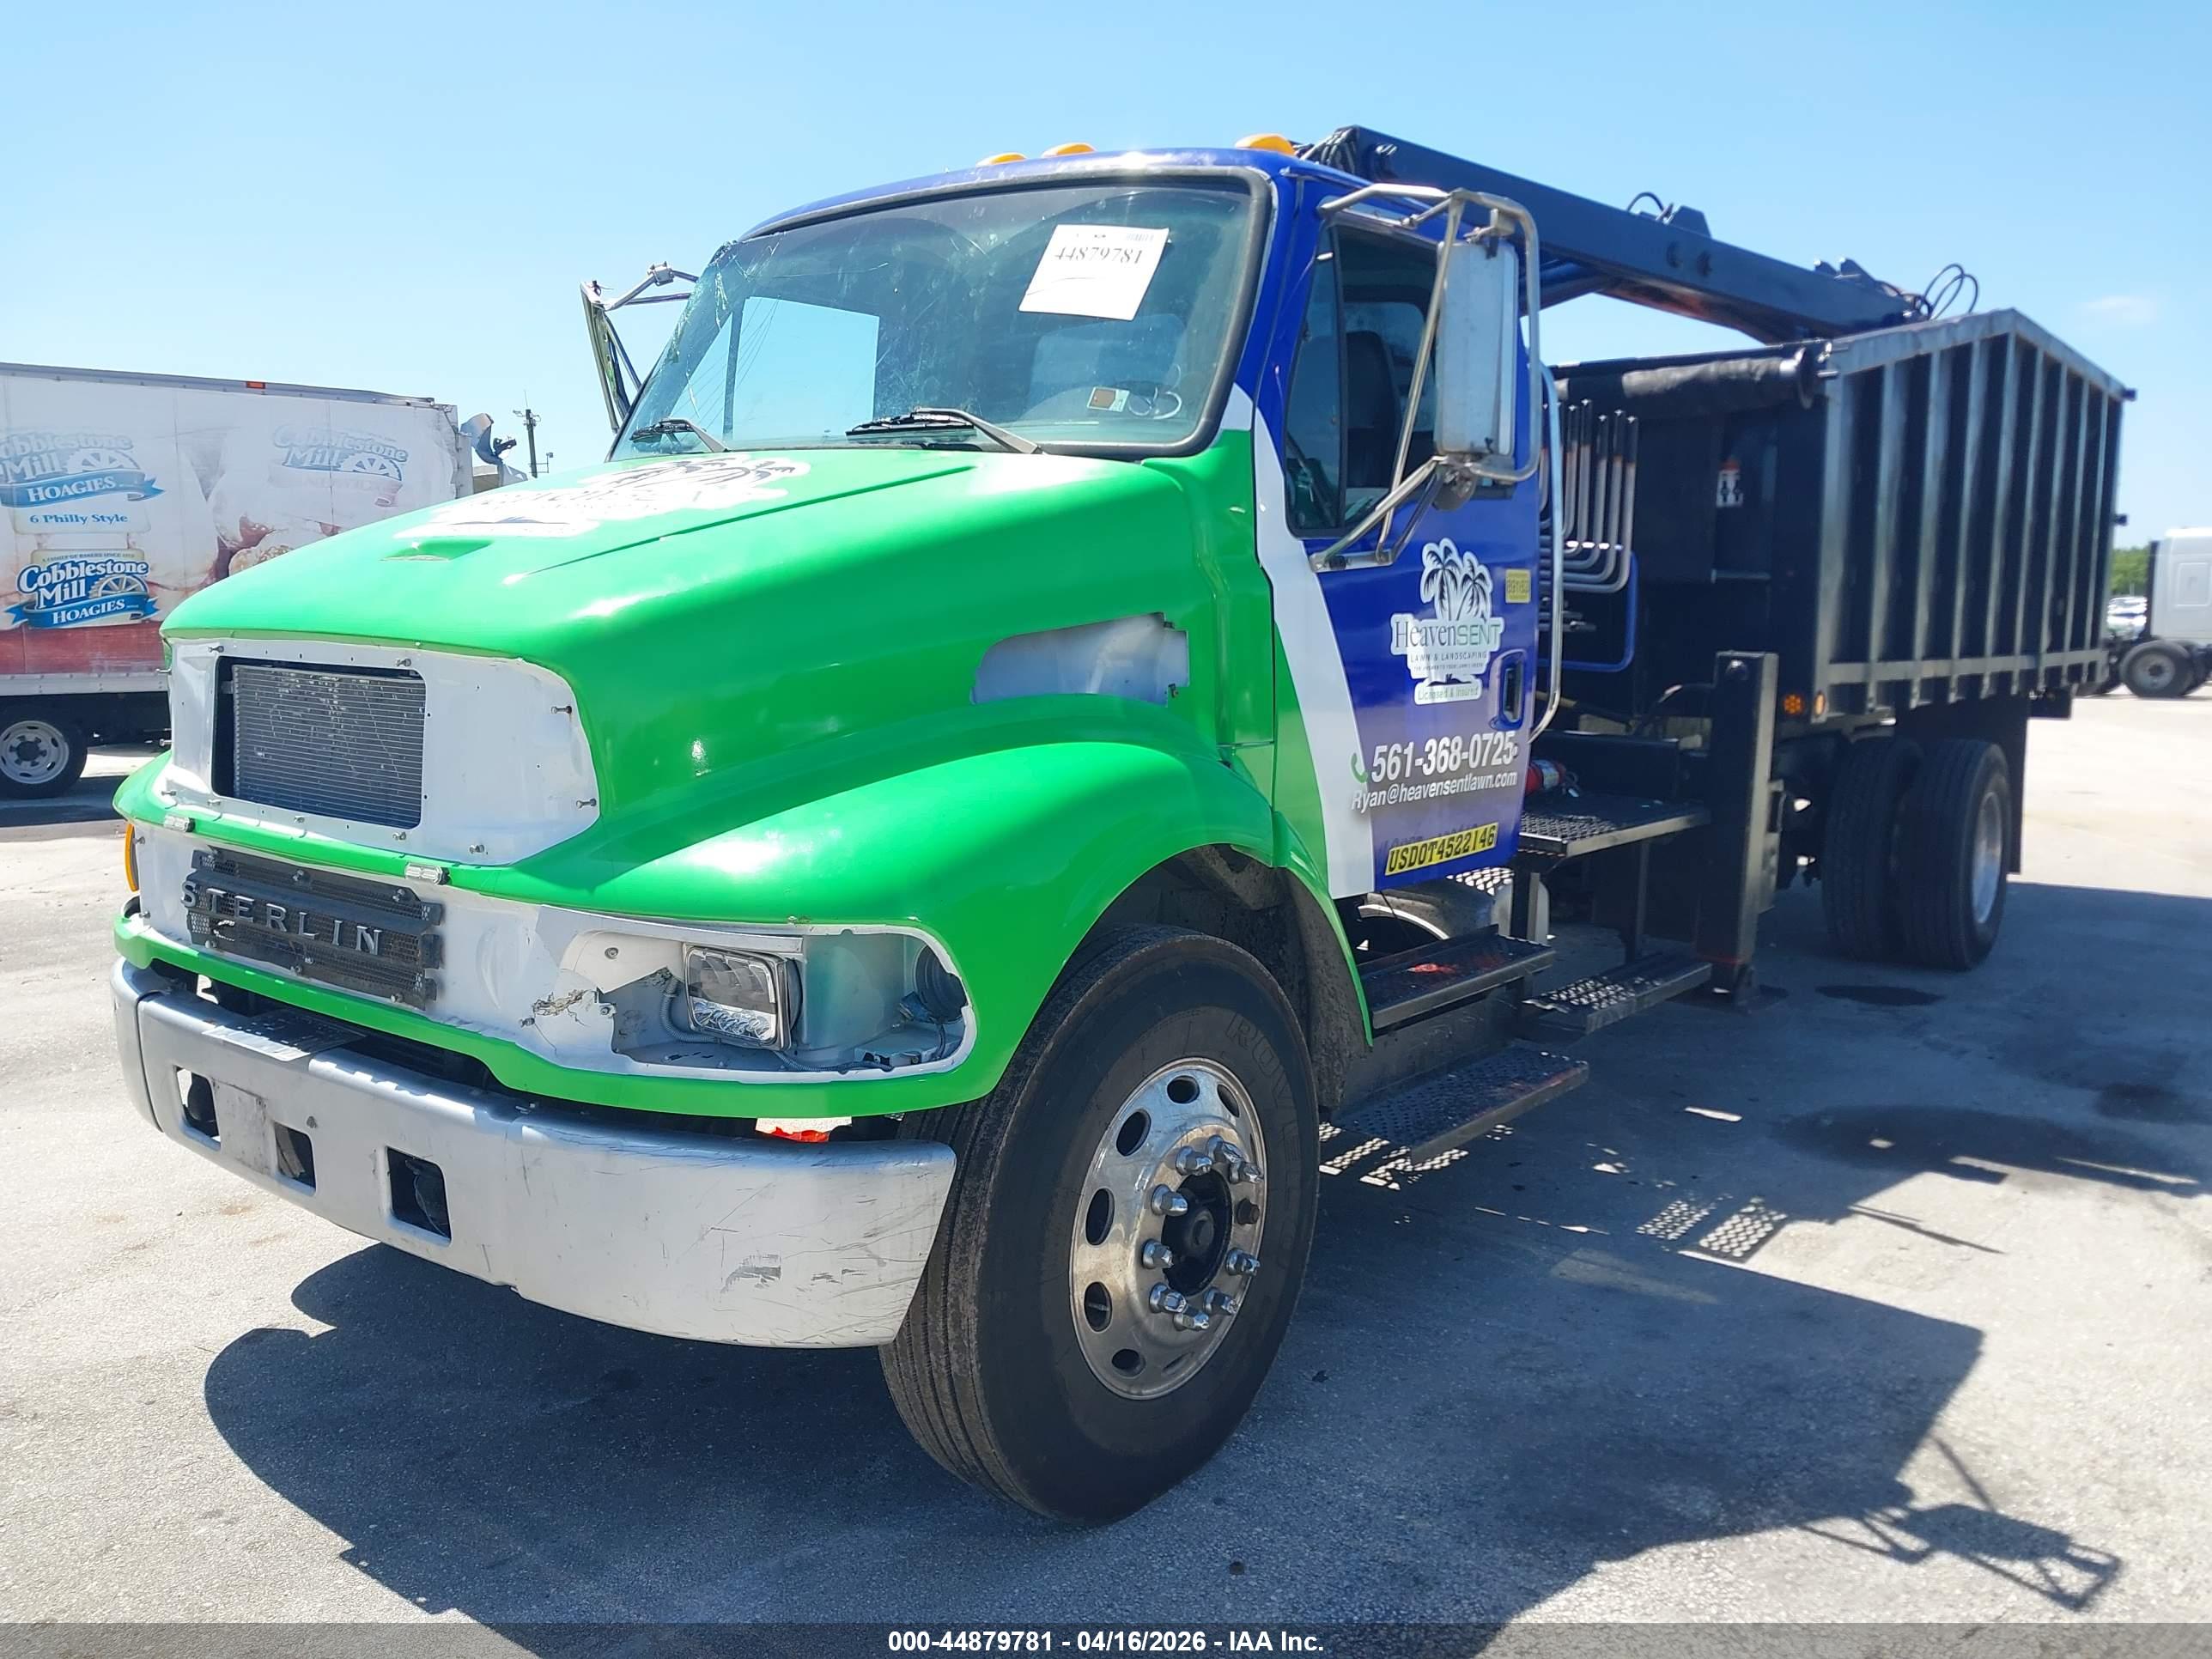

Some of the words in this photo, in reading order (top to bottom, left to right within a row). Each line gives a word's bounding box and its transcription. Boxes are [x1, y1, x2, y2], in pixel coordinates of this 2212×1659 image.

[1054, 246, 1143, 264] 44879781
[0, 431, 134, 460] obblestone
[283, 446, 342, 467] Mill
[3, 452, 68, 483] Mill
[27, 476, 117, 502] HOAGIES
[29, 514, 40, 523] 6
[44, 514, 88, 526] Philly
[91, 514, 128, 525] Style
[19, 559, 149, 593] Cobblestone
[38, 578, 86, 609] Mill
[52, 599, 125, 624] HOAGIES
[1410, 653, 1431, 664] LAWN
[1441, 651, 1487, 662] LANDSCAPING
[1371, 731, 1516, 783] 561-368-0725
[1352, 771, 1518, 814] Ryan@heavensentlawn.com
[1388, 824, 1497, 872] USDOT4522146
[180, 880, 383, 956] STERLIN
